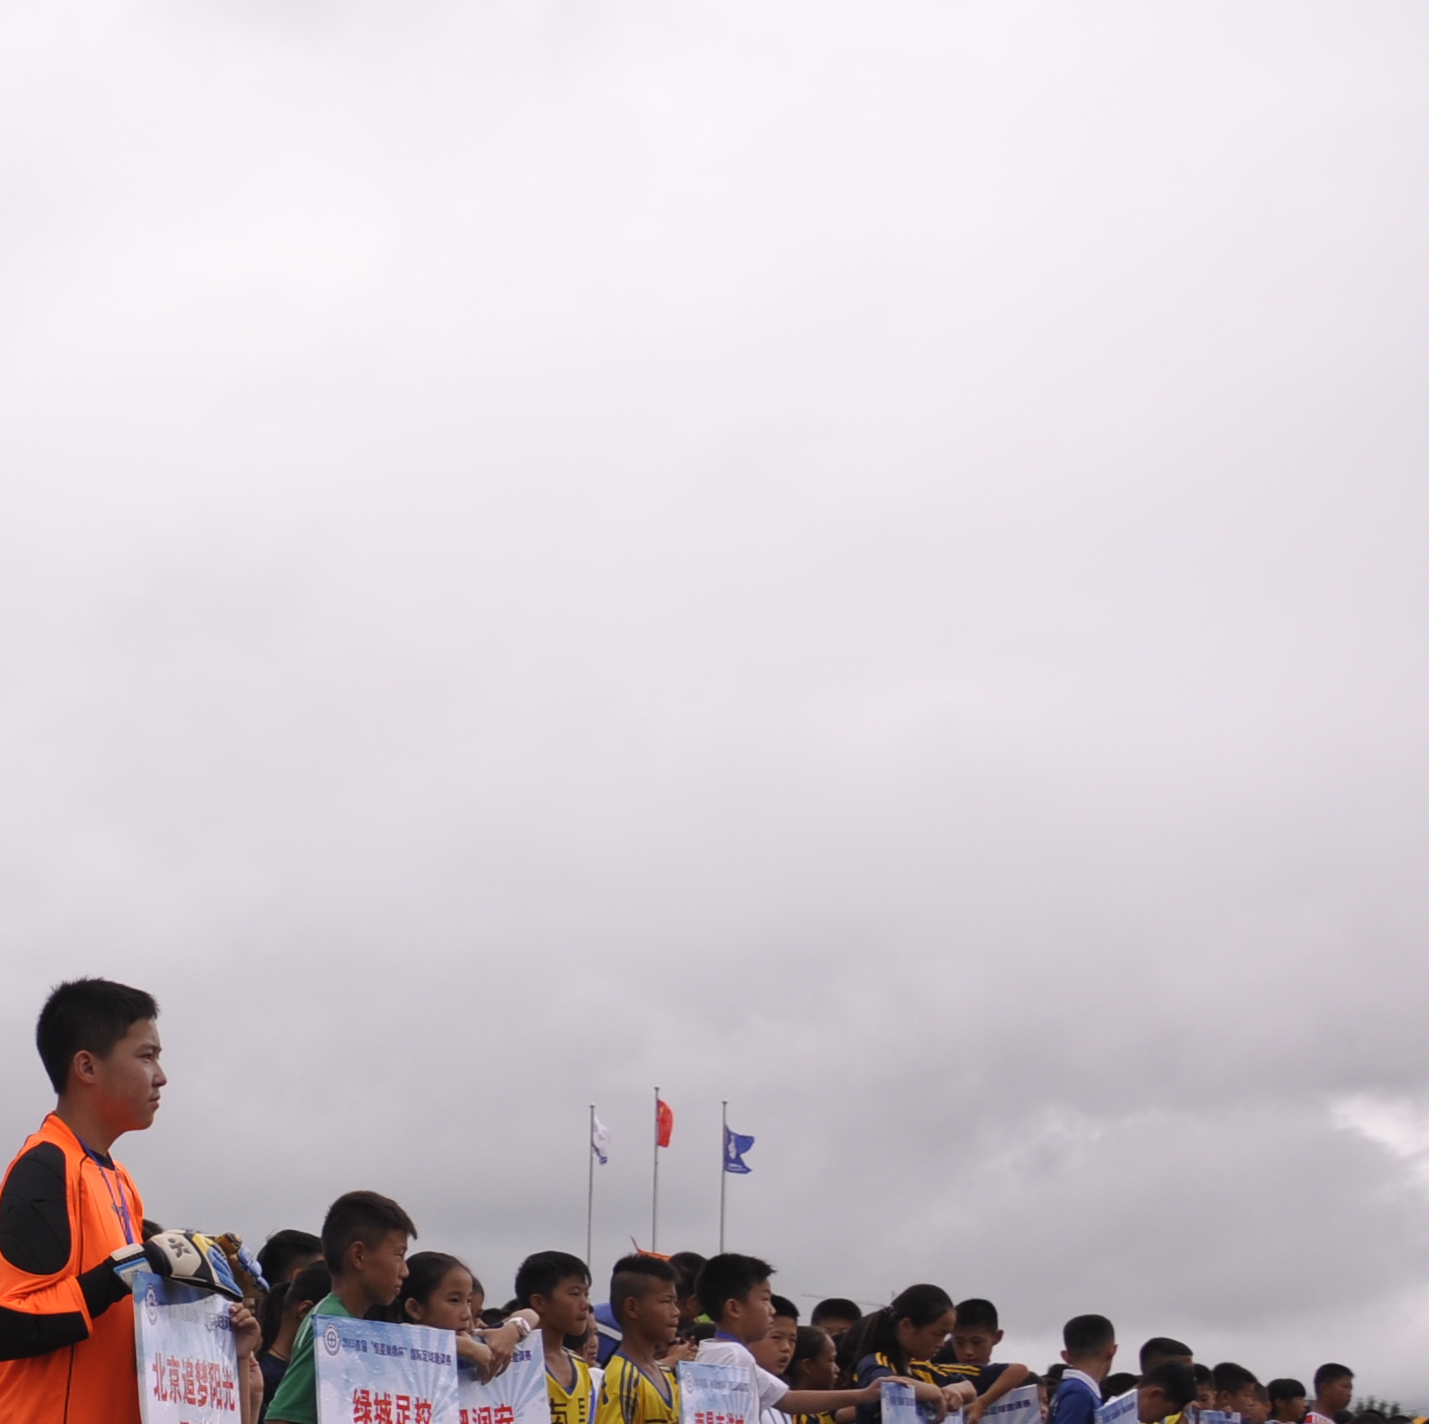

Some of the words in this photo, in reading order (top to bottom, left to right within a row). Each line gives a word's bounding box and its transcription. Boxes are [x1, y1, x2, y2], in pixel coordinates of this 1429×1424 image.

[152, 1352, 236, 1412] 北京追梦阳光
